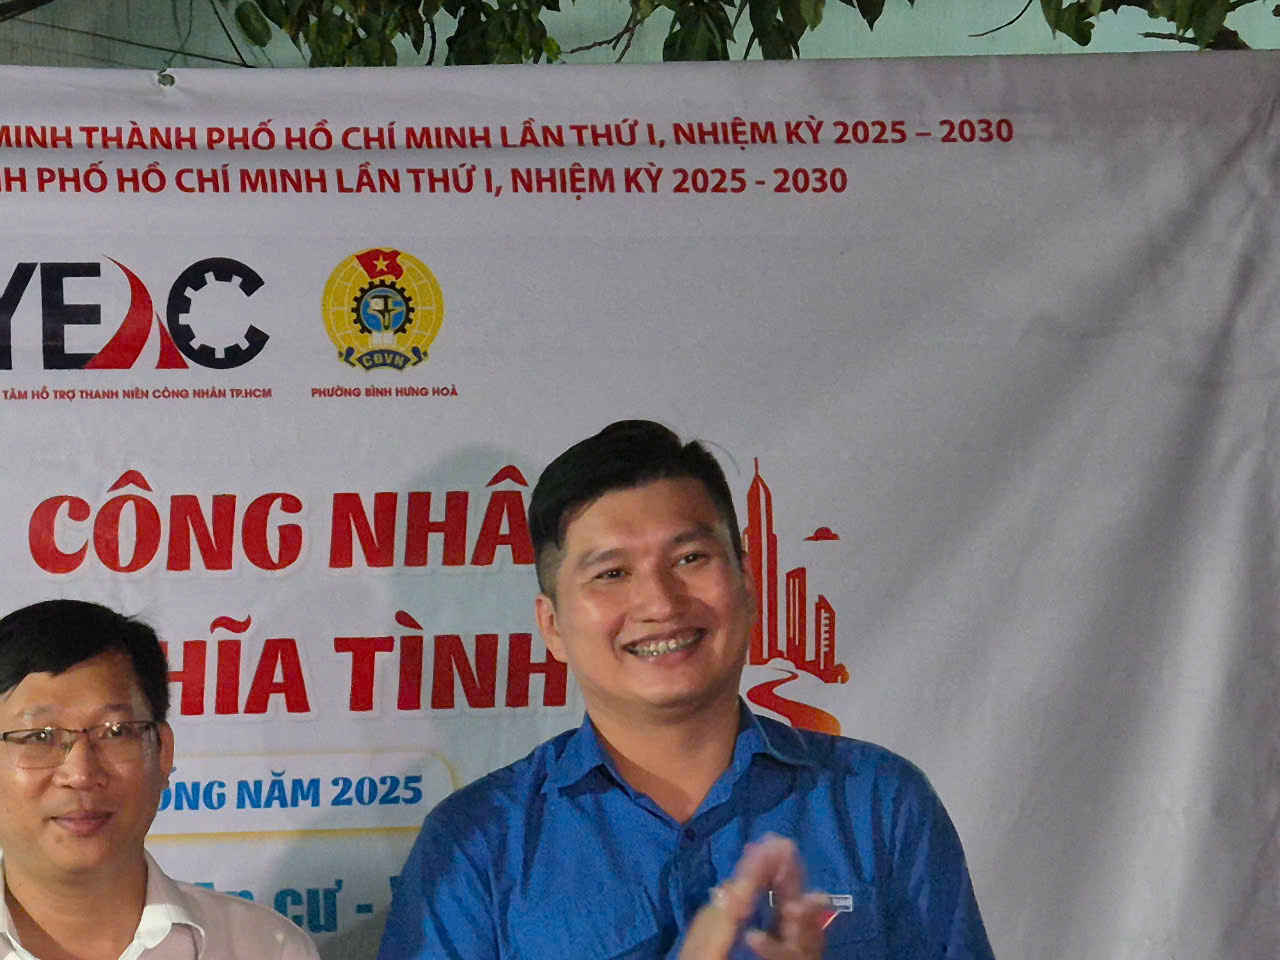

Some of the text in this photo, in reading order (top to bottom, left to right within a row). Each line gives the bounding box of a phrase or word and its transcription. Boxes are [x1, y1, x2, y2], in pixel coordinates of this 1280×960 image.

[81, 119, 197, 150] THÀNH
[205, 117, 276, 150] PHỐ
[285, 117, 333, 150] HỒ
[341, 120, 397, 149] CHÍ
[405, 125, 491, 149] MINH
[500, 117, 564, 149] LẦN
[569, 119, 639, 147] THỨ
[672, 118, 777, 151] NHIỆM
[785, 114, 824, 144] KỲ
[833, 121, 907, 144] 2025
[940, 119, 1014, 143] 2030
[37, 163, 108, 194] PHỐ
[117, 161, 167, 194] HỒ
[175, 165, 230, 194] CHÍ
[239, 169, 327, 194] MINH
[336, 161, 401, 194] LẦN
[411, 164, 477, 194] THỨ
[511, 163, 616, 200] NHIỆM
[623, 163, 664, 193] KỲ
[672, 168, 747, 193] 2025
[773, 168, 848, 193] 2030
[3, 387, 28, 400] TÂM
[31, 385, 49, 400] HỖ
[53, 388, 76, 402] TRỢ
[79, 389, 119, 400] THANH
[122, 387, 149, 399] NIÊN
[152, 387, 189, 399] CÔNG
[193, 386, 226, 398] NHÂN
[230, 388, 272, 398] TP.HCM
[311, 385, 361, 398] PHƯỜNG
[365, 385, 392, 397] BÌNH
[396, 386, 429, 397] HƯNG
[29, 470, 304, 575] CÔNG
[328, 465, 536, 568] NHÂ
[158, 614, 311, 716] HĨA
[334, 610, 568, 712] TÌNH
[236, 769, 320, 810] NĂM
[330, 775, 423, 807] 2025
